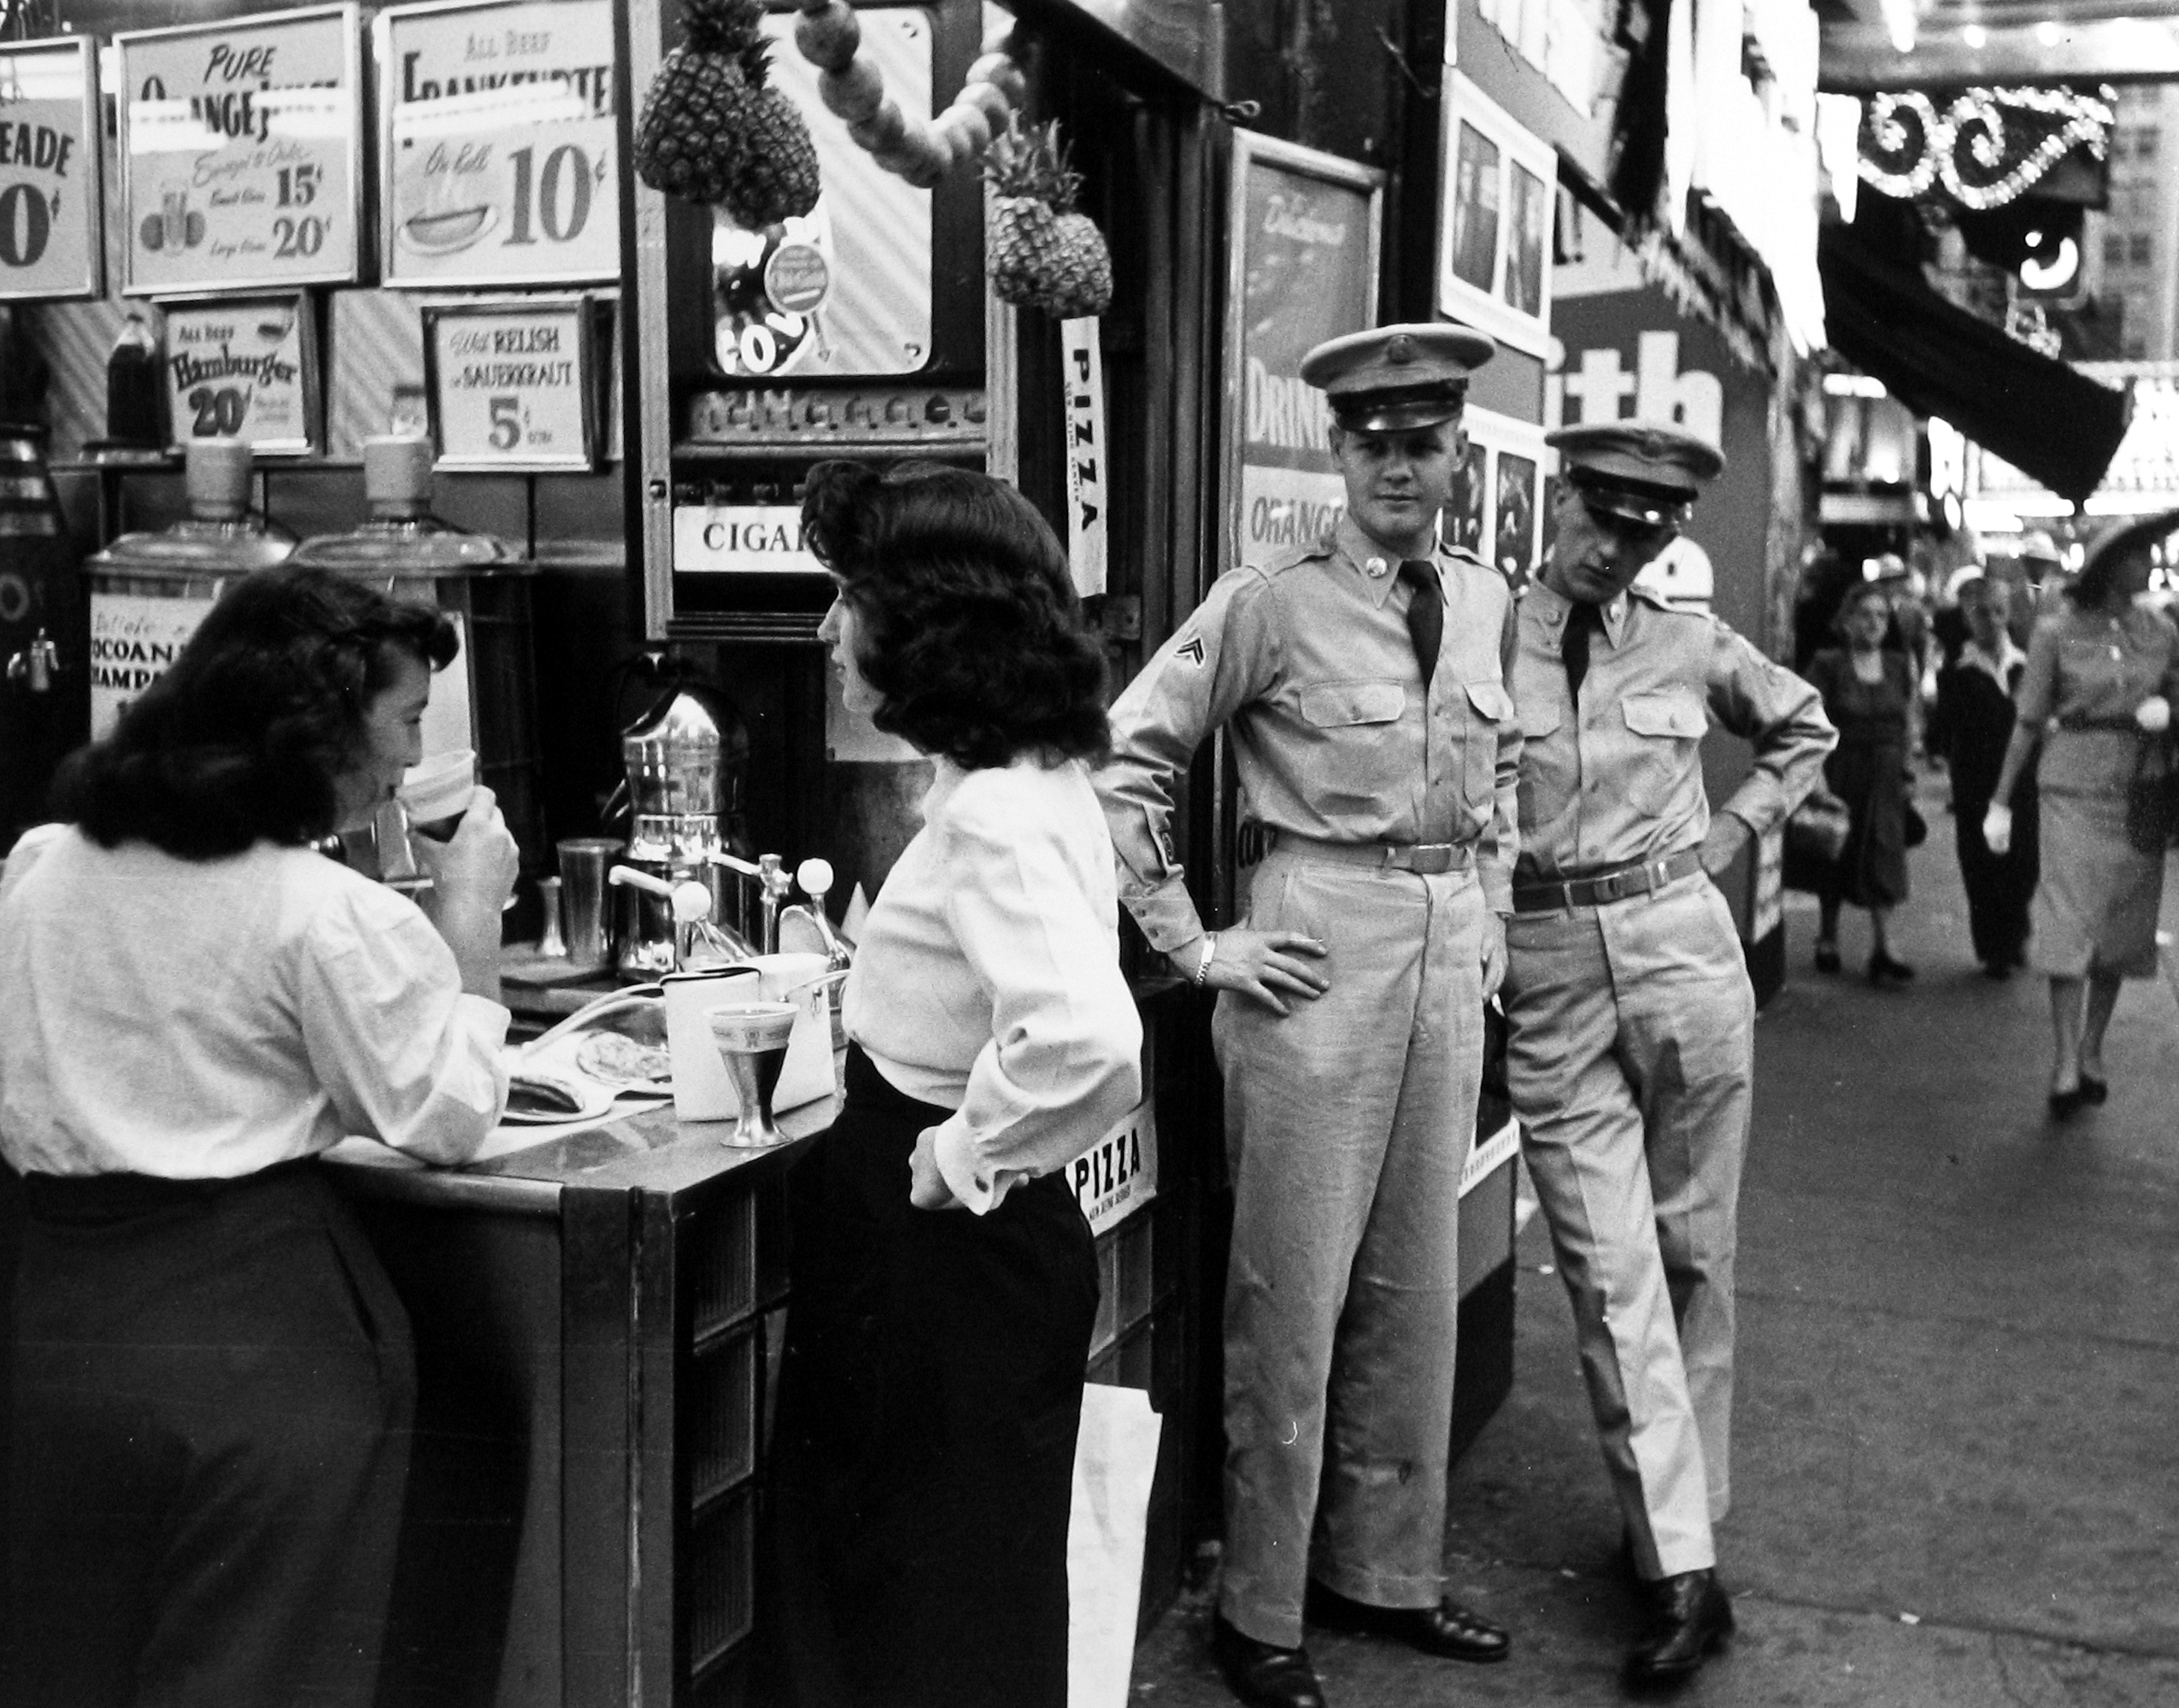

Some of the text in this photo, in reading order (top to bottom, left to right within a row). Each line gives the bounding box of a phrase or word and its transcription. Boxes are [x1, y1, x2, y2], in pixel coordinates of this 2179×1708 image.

[203, 44, 276, 83] PURE
[170, 343, 297, 391] Hamburger
[1246, 355, 1333, 453] DRIN
[1073, 349, 1099, 531] PIZZA
[1075, 1127, 1141, 1209] PIZZA
